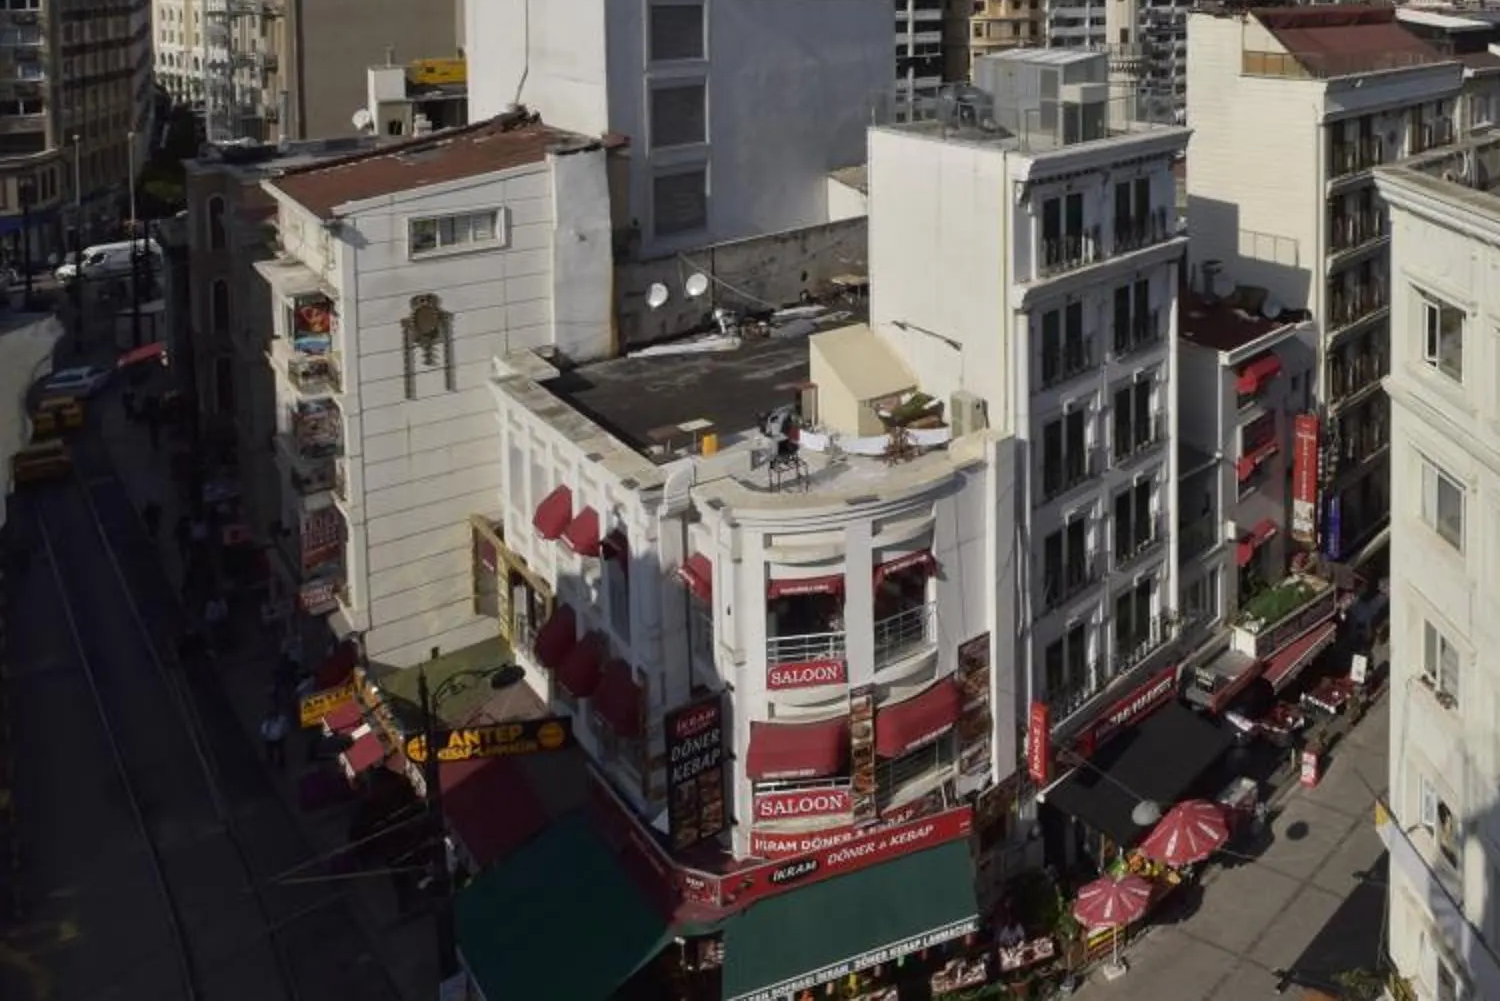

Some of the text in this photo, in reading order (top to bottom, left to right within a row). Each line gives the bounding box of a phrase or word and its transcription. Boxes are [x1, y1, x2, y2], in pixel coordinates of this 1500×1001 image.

[771, 665, 838, 685] SALOON
[448, 725, 523, 747] ANTEP
[671, 727, 721, 762] DÖNER
[672, 748, 721, 784] KEBAP
[760, 795, 843, 817] SALOON
[827, 842, 875, 865] DÖNER
[890, 824, 934, 846] KEBAP
